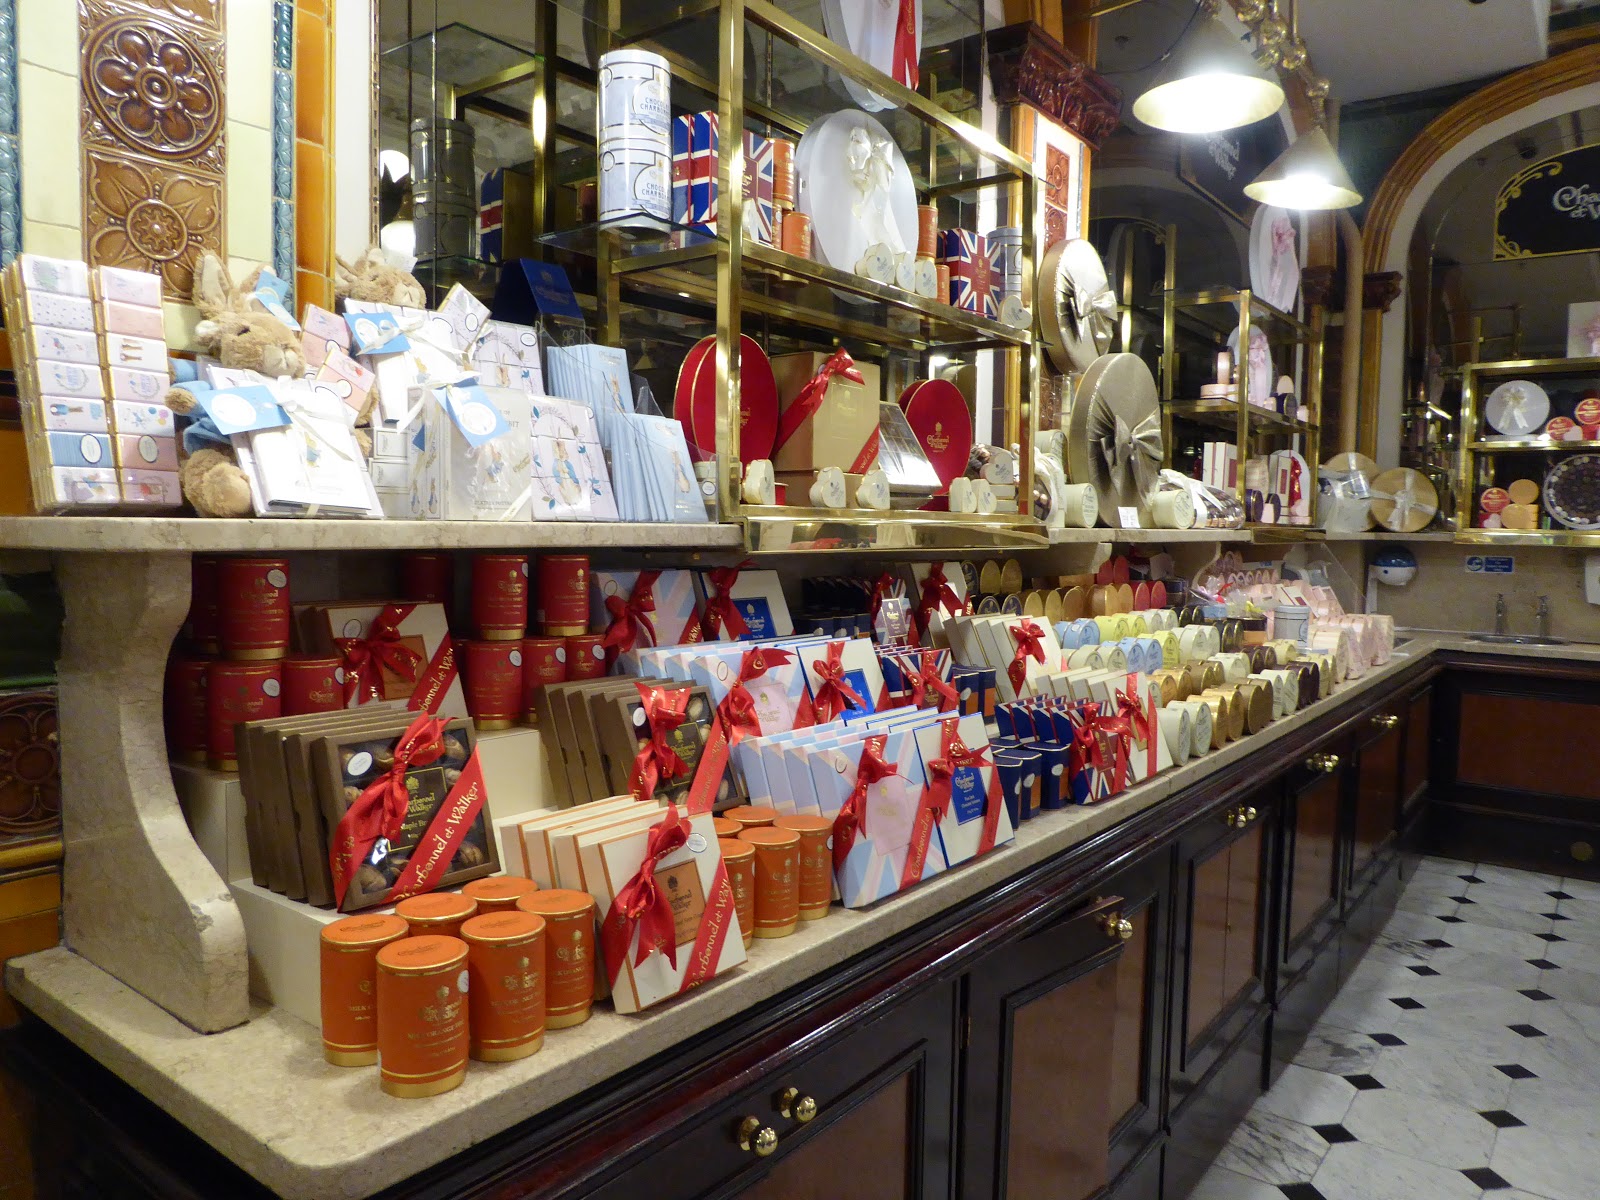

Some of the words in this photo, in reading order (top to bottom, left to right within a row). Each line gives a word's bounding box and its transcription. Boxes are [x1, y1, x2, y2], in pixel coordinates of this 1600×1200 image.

[418, 677, 441, 711] bonnel
[439, 647, 454, 670] Wal
[447, 781, 479, 824] Walker
[445, 826, 455, 839] et
[714, 910, 723, 923] et
